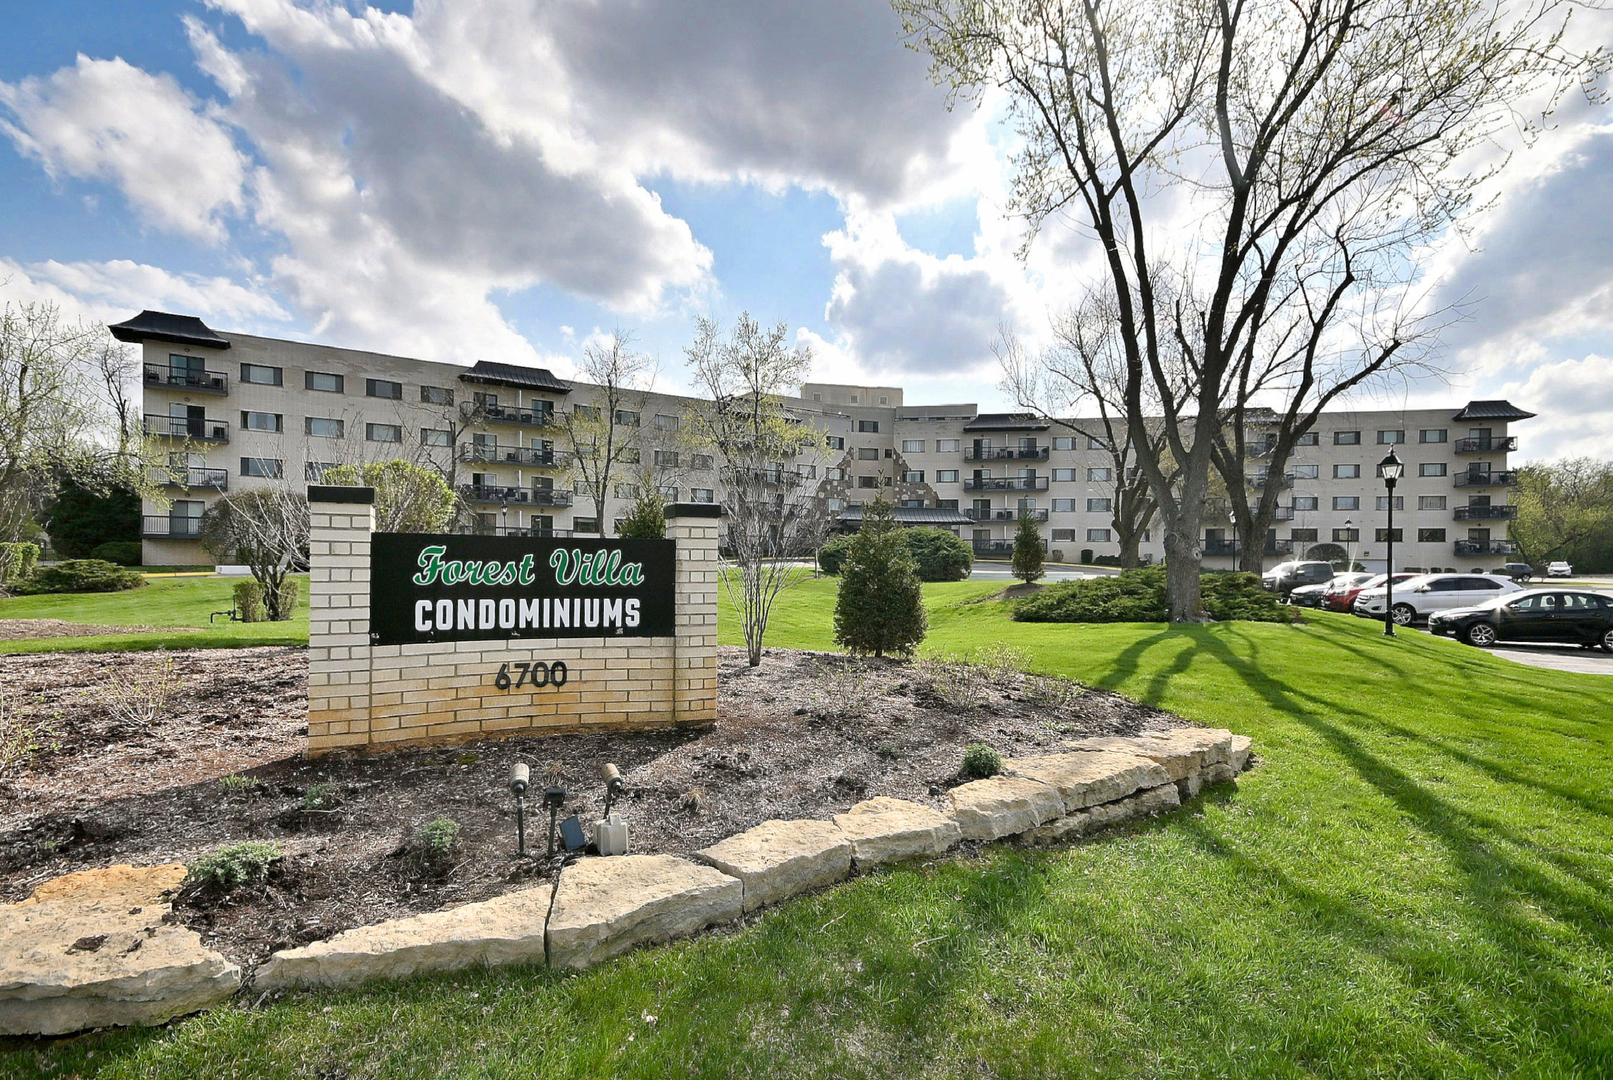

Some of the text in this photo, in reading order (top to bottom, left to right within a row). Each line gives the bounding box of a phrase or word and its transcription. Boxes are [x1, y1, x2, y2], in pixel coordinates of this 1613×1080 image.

[412, 545, 645, 586] Forest Villa
[414, 597, 641, 632] CONDOMINIUMS
[494, 661, 568, 690] 6700
